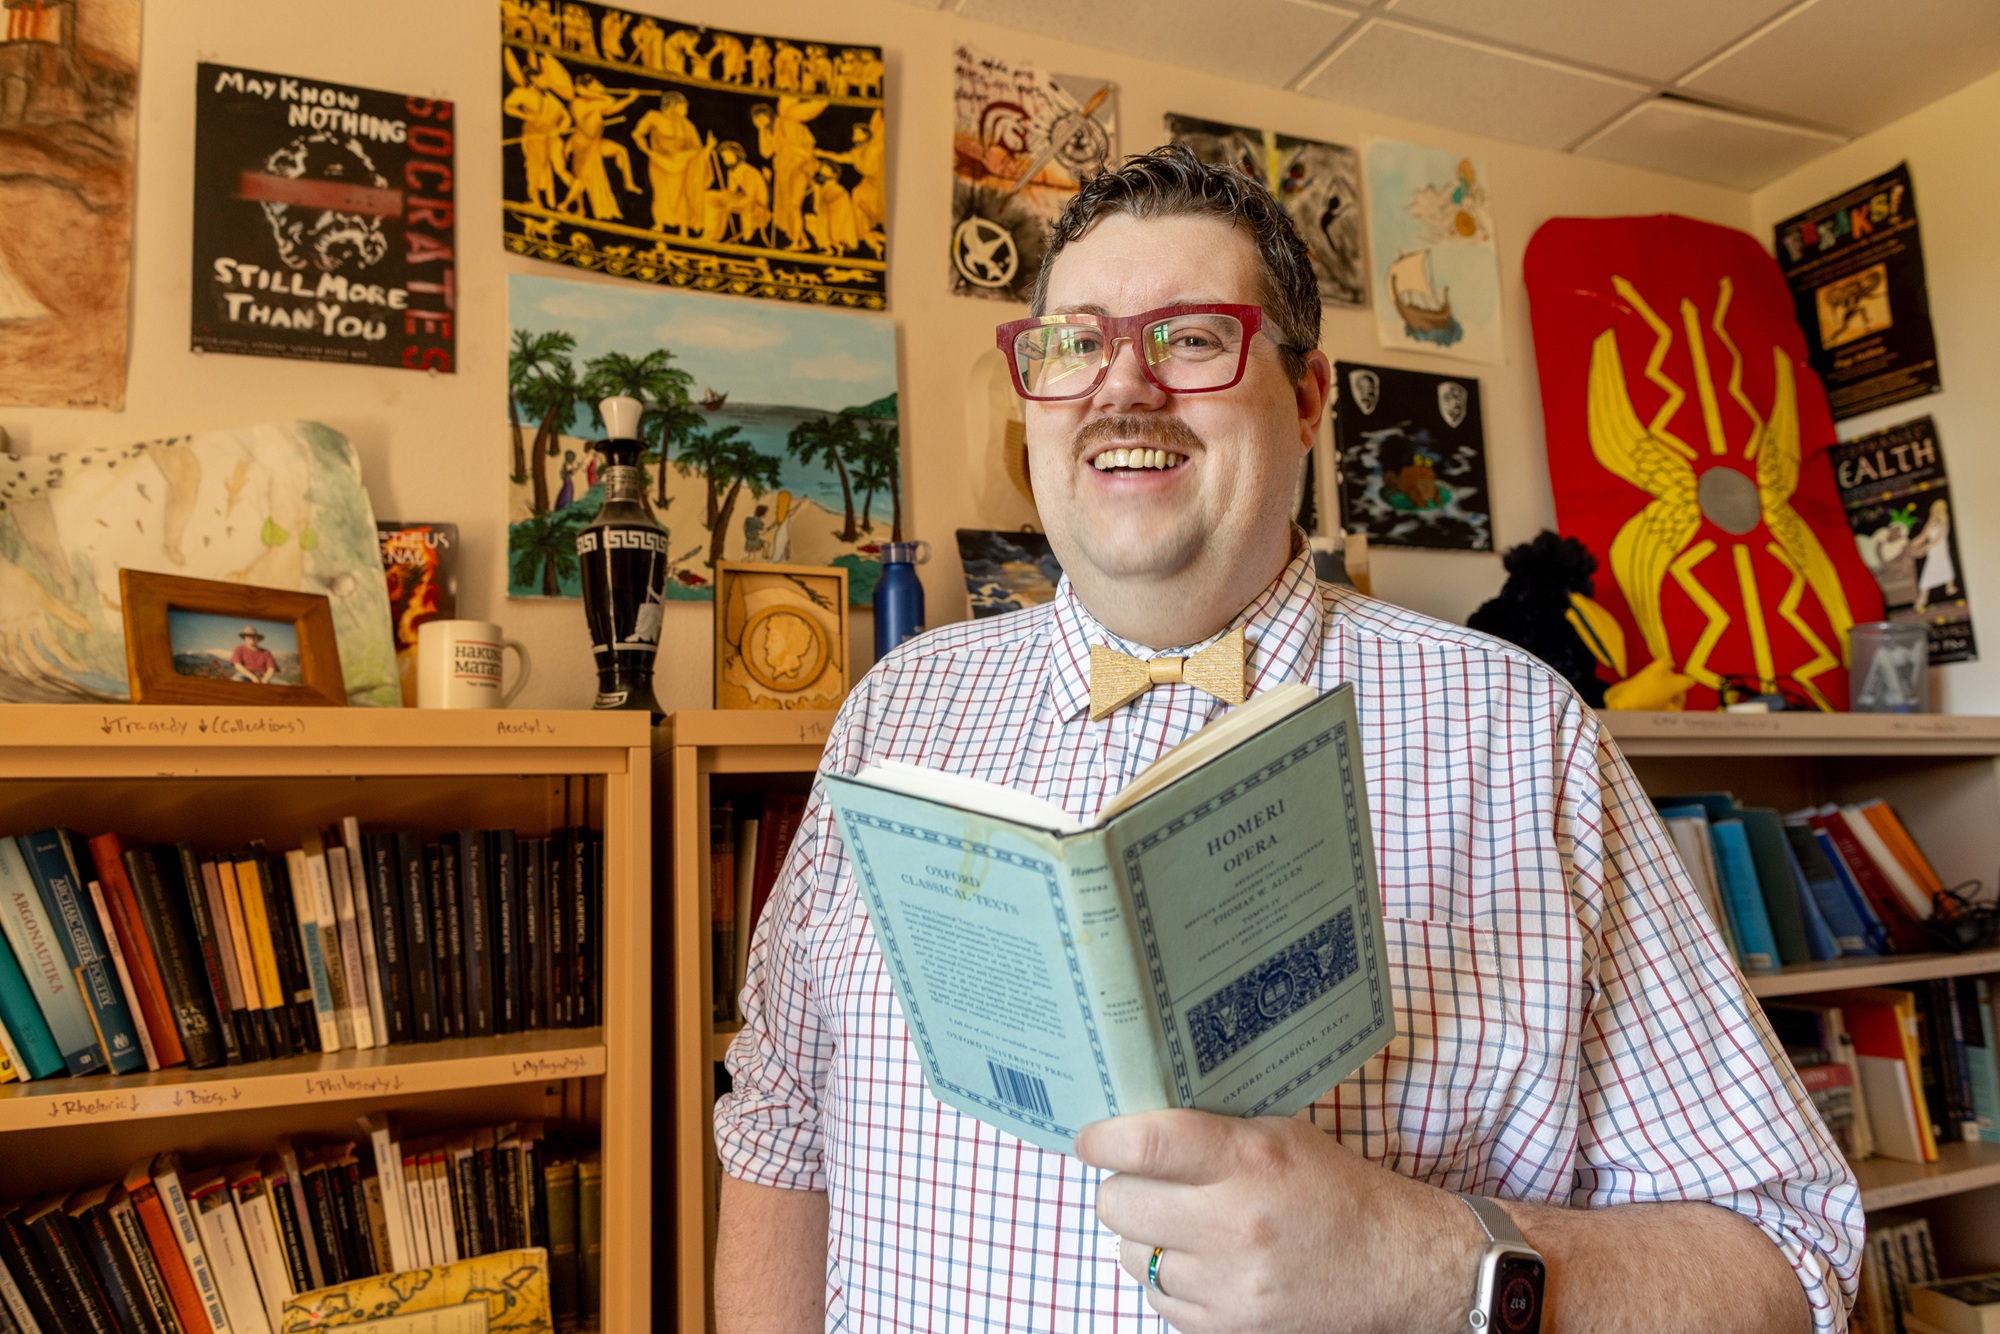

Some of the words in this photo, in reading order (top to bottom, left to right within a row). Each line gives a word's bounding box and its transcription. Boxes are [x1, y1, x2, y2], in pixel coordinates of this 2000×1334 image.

[287, 103, 408, 144] NOTHING
[402, 95, 455, 373] SOCRATES
[213, 256, 315, 299] STILL
[316, 271, 409, 310] MORE
[222, 292, 316, 330] THAN
[316, 300, 387, 342] YOU
[1837, 437, 1937, 489] EALTH
[109, 716, 188, 736] Tragedy
[1206, 799, 1287, 857] HOMERI
[1223, 834, 1279, 874] OPERA
[900, 873, 970, 902] CLASSICAL
[973, 893, 1020, 916] TEXTS
[925, 864, 981, 889] OXFORD
[1213, 893, 1255, 926] THOMAS
[1257, 885, 1268, 898] W.
[1270, 863, 1303, 890] ALLEN
[12, 890, 65, 996] ARGONAUTIKA
[53, 878, 82, 928] ARCHAIC
[73, 925, 96, 966] GREEK
[90, 961, 116, 1008] POETRY
[1222, 1071, 1263, 1104] OXFORD
[1265, 1035, 1318, 1075] CLASSICAL
[1319, 1011, 1351, 1039] TEXTS
[61, 1095, 127, 1117] Rhetoric
